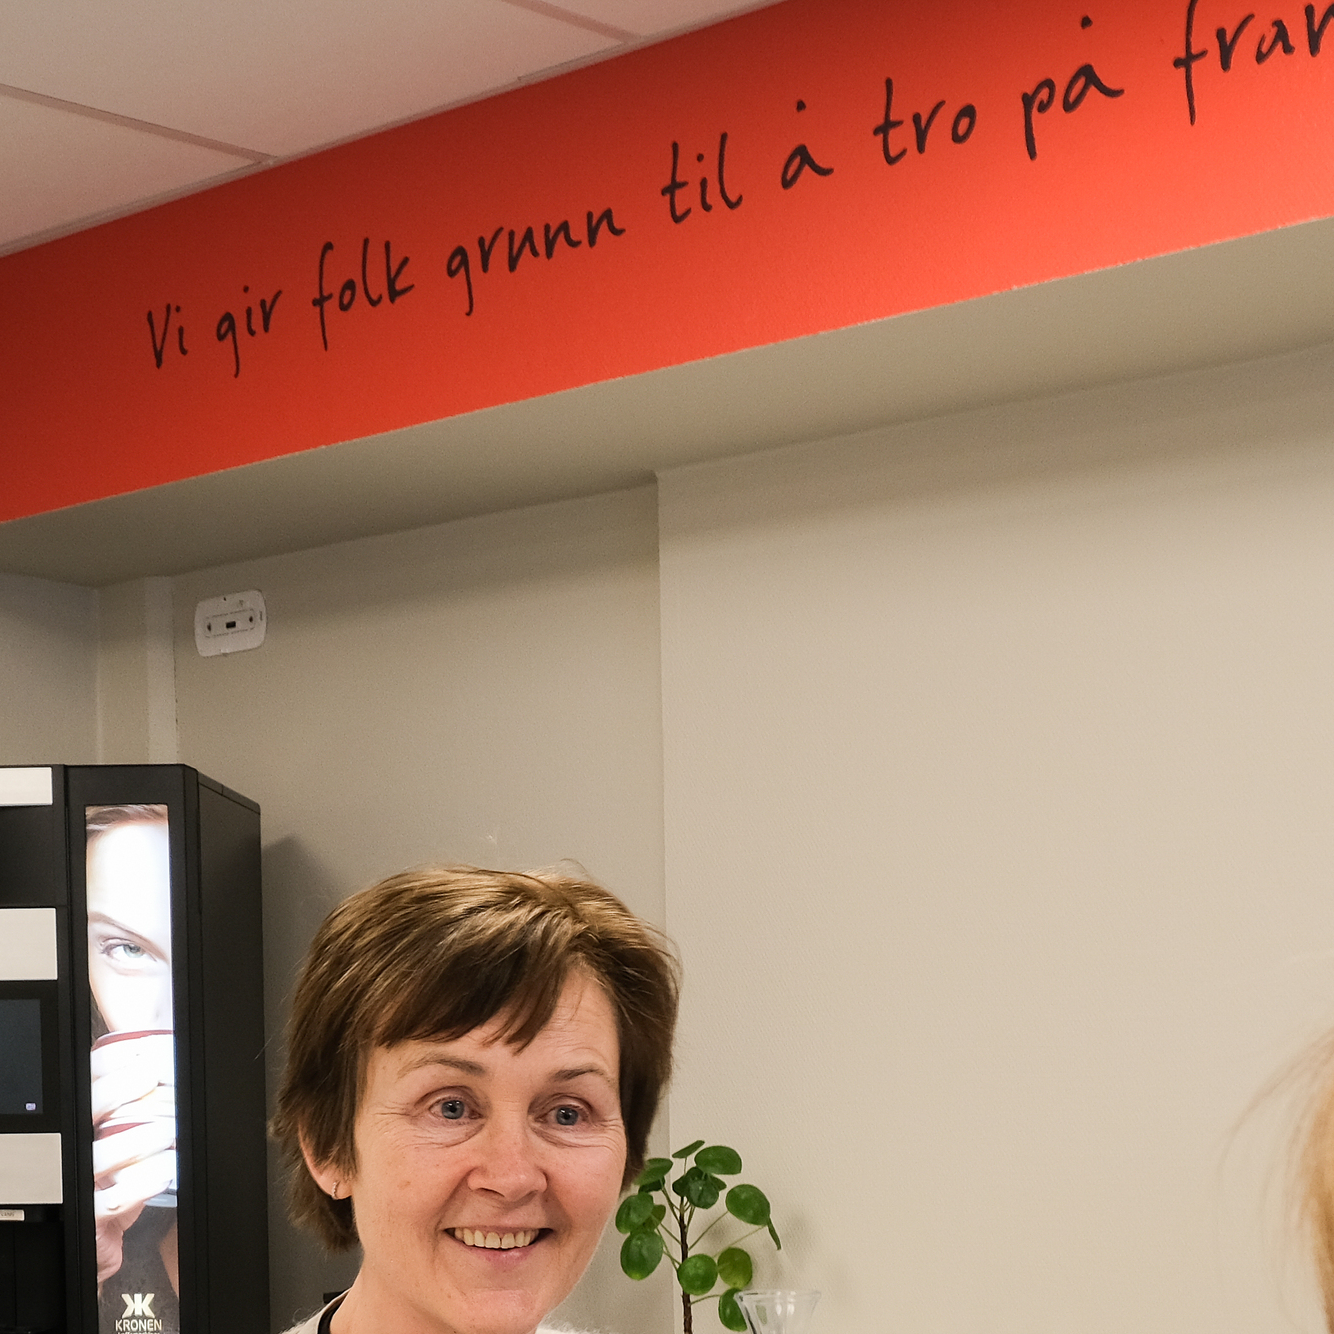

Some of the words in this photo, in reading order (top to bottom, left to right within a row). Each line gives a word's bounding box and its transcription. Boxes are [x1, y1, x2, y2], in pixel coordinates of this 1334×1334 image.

[146, 302, 189, 370] Vi
[215, 285, 283, 378] gir
[310, 236, 416, 351] folk
[445, 206, 627, 317] grunn
[660, 131, 744, 225] til
[780, 98, 835, 191] å
[871, 76, 978, 167] tro
[1020, 14, 1126, 162] på
[115, 1319, 163, 1332] KRONEN
